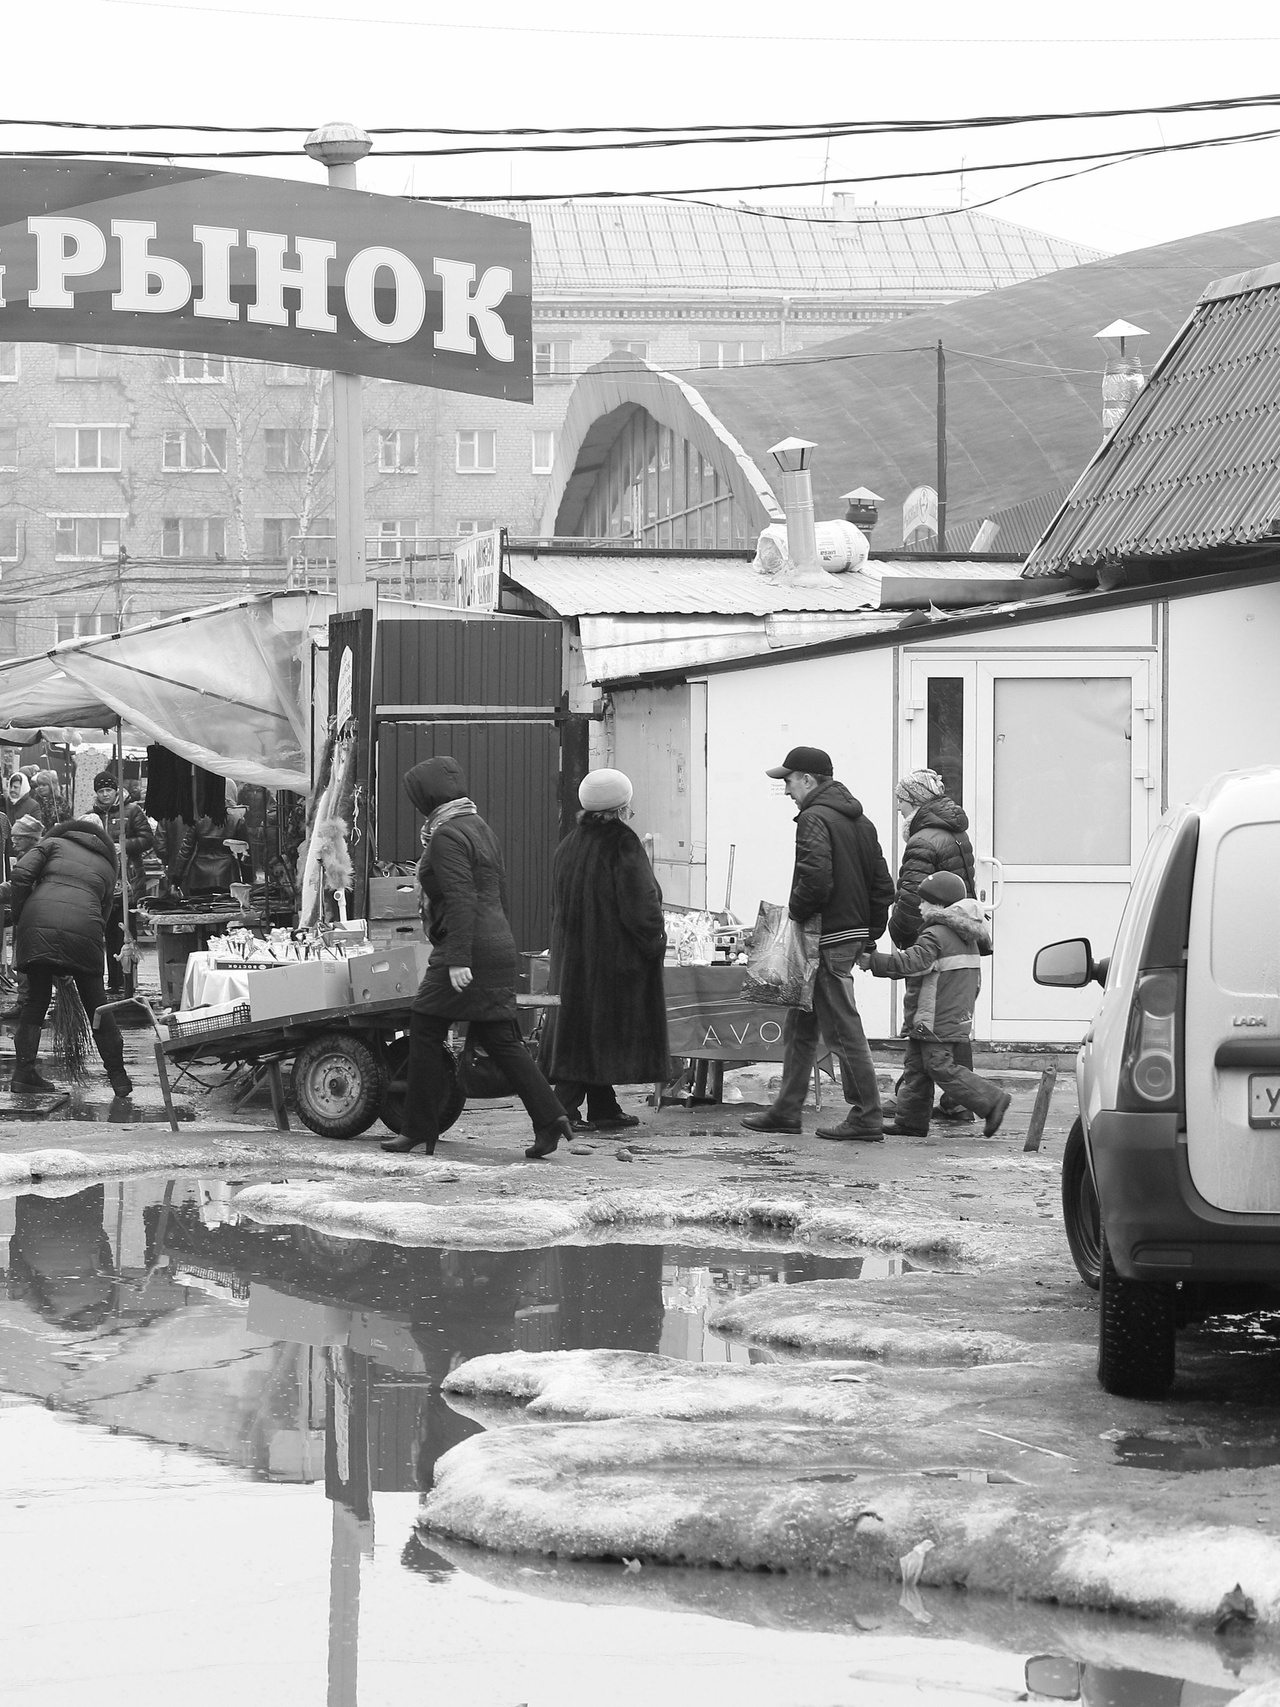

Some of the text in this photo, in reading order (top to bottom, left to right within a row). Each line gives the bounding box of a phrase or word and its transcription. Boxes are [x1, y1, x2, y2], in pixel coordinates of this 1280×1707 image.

[27, 215, 516, 363] РЫНОК
[702, 1021, 782, 1046] AVO
[1233, 1016, 1267, 1027] LADA
